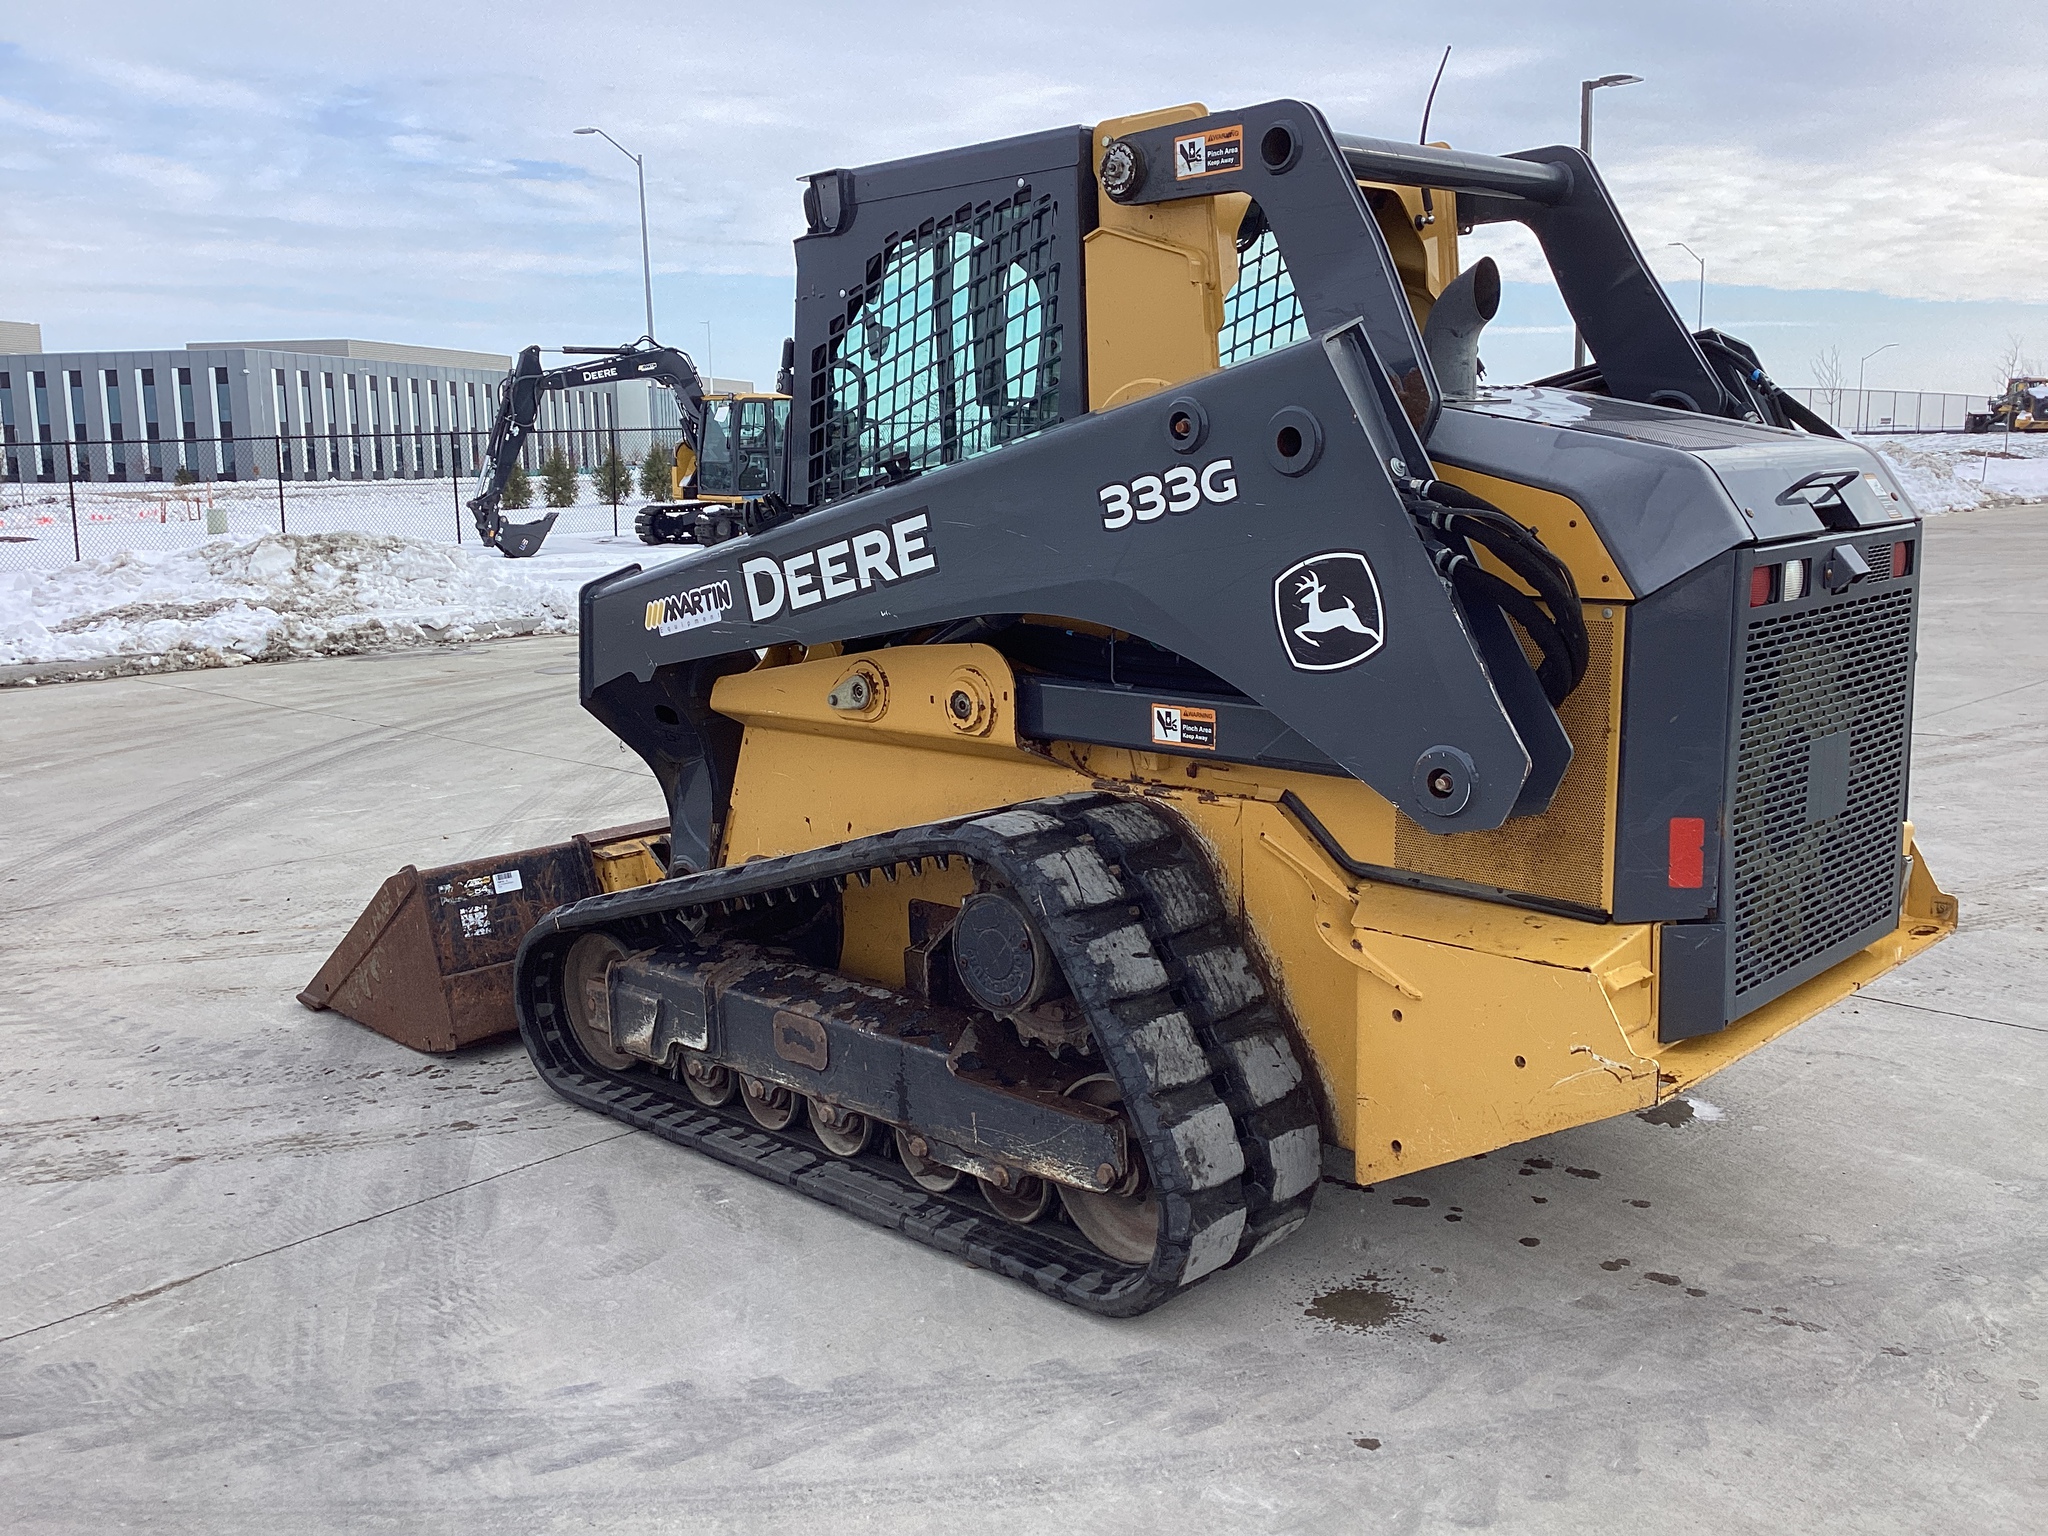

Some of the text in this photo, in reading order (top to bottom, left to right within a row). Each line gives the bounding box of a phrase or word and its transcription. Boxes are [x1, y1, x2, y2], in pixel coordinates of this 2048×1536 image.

[1207, 147, 1238, 158] Pinch Area
[1207, 157, 1234, 167] Keep Away
[582, 367, 618, 382] DEERE
[1099, 459, 1238, 529] 333G
[742, 513, 936, 622] DEERE
[662, 580, 732, 624] MARTIN
[1188, 711, 1213, 719] WARNING
[1182, 724, 1198, 732] Pinch
[1182, 732, 1208, 742] Keep Away
